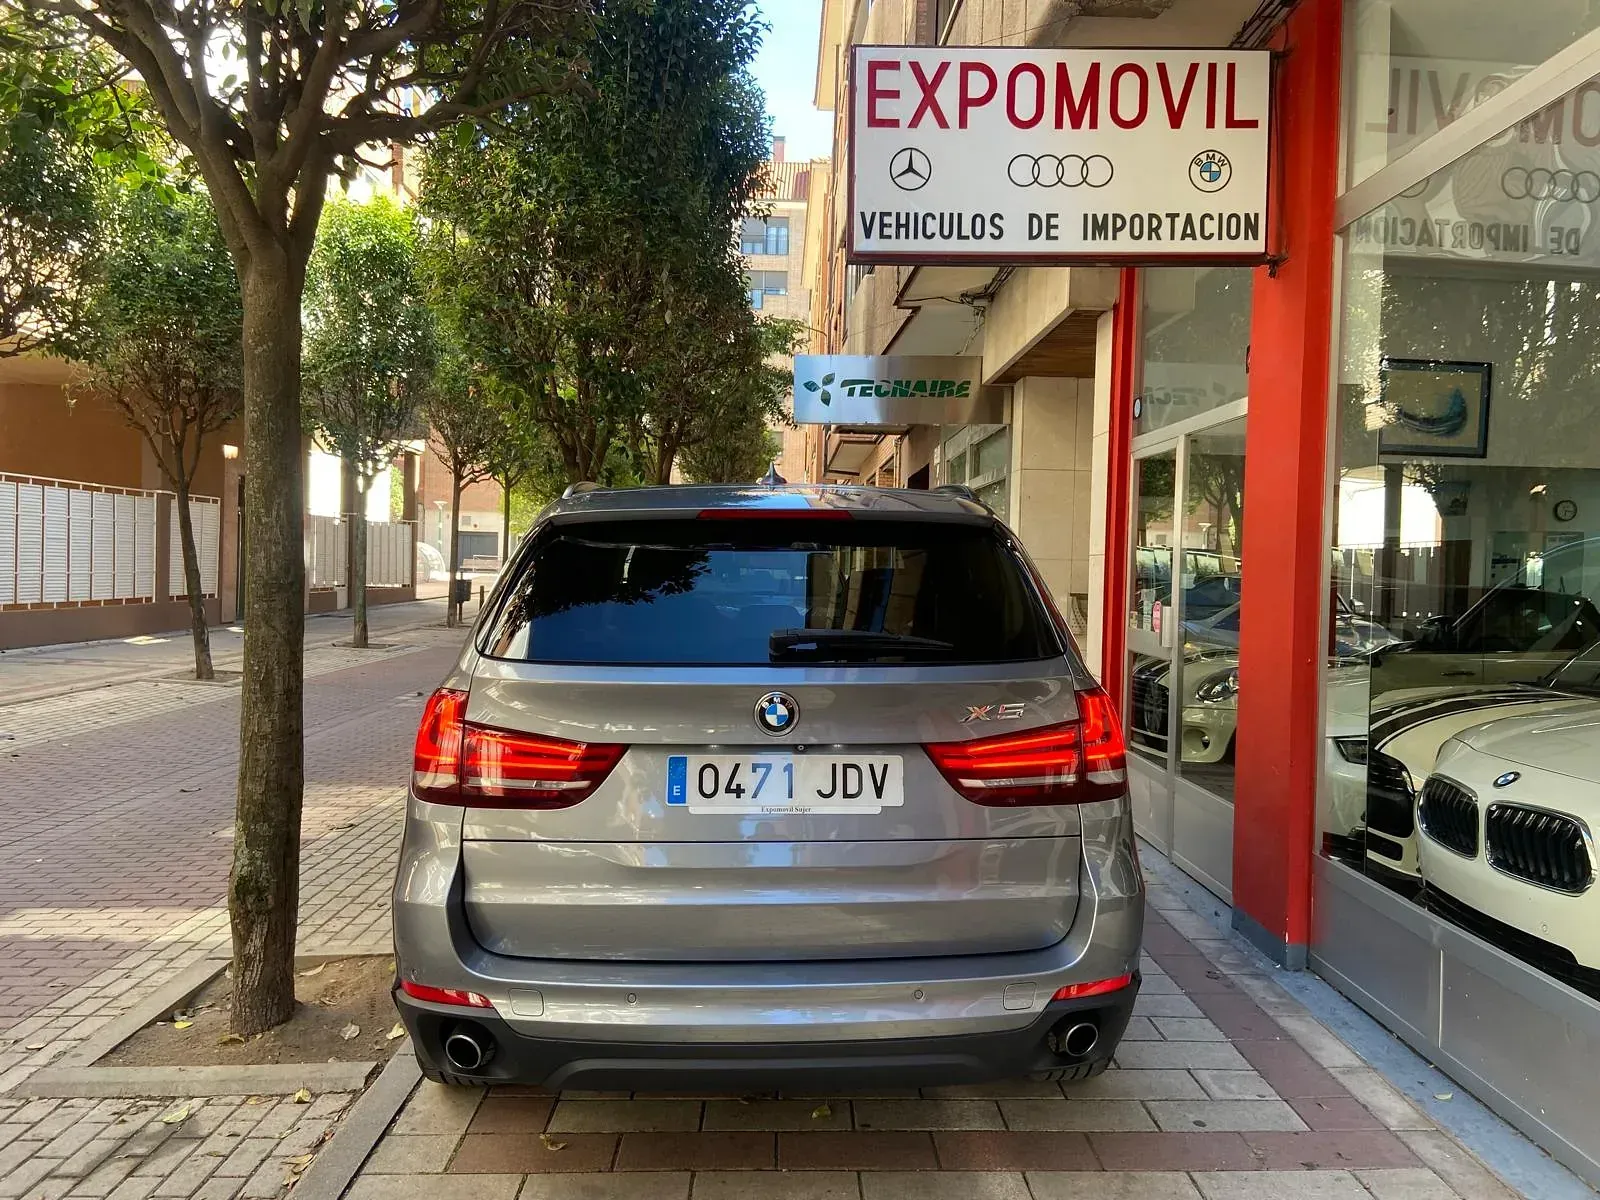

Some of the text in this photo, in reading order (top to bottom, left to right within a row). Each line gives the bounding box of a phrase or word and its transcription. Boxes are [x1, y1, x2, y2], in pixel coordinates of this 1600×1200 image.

[867, 60, 1259, 130] EXPOMOVIL
[1194, 153, 1228, 167] BMW
[860, 211, 1260, 241] VEHICULOS DE IMPORTACION
[840, 379, 972, 398] TECNAIRE
[959, 703, 1026, 723] X5
[673, 762, 889, 800] E 0471 JDV
